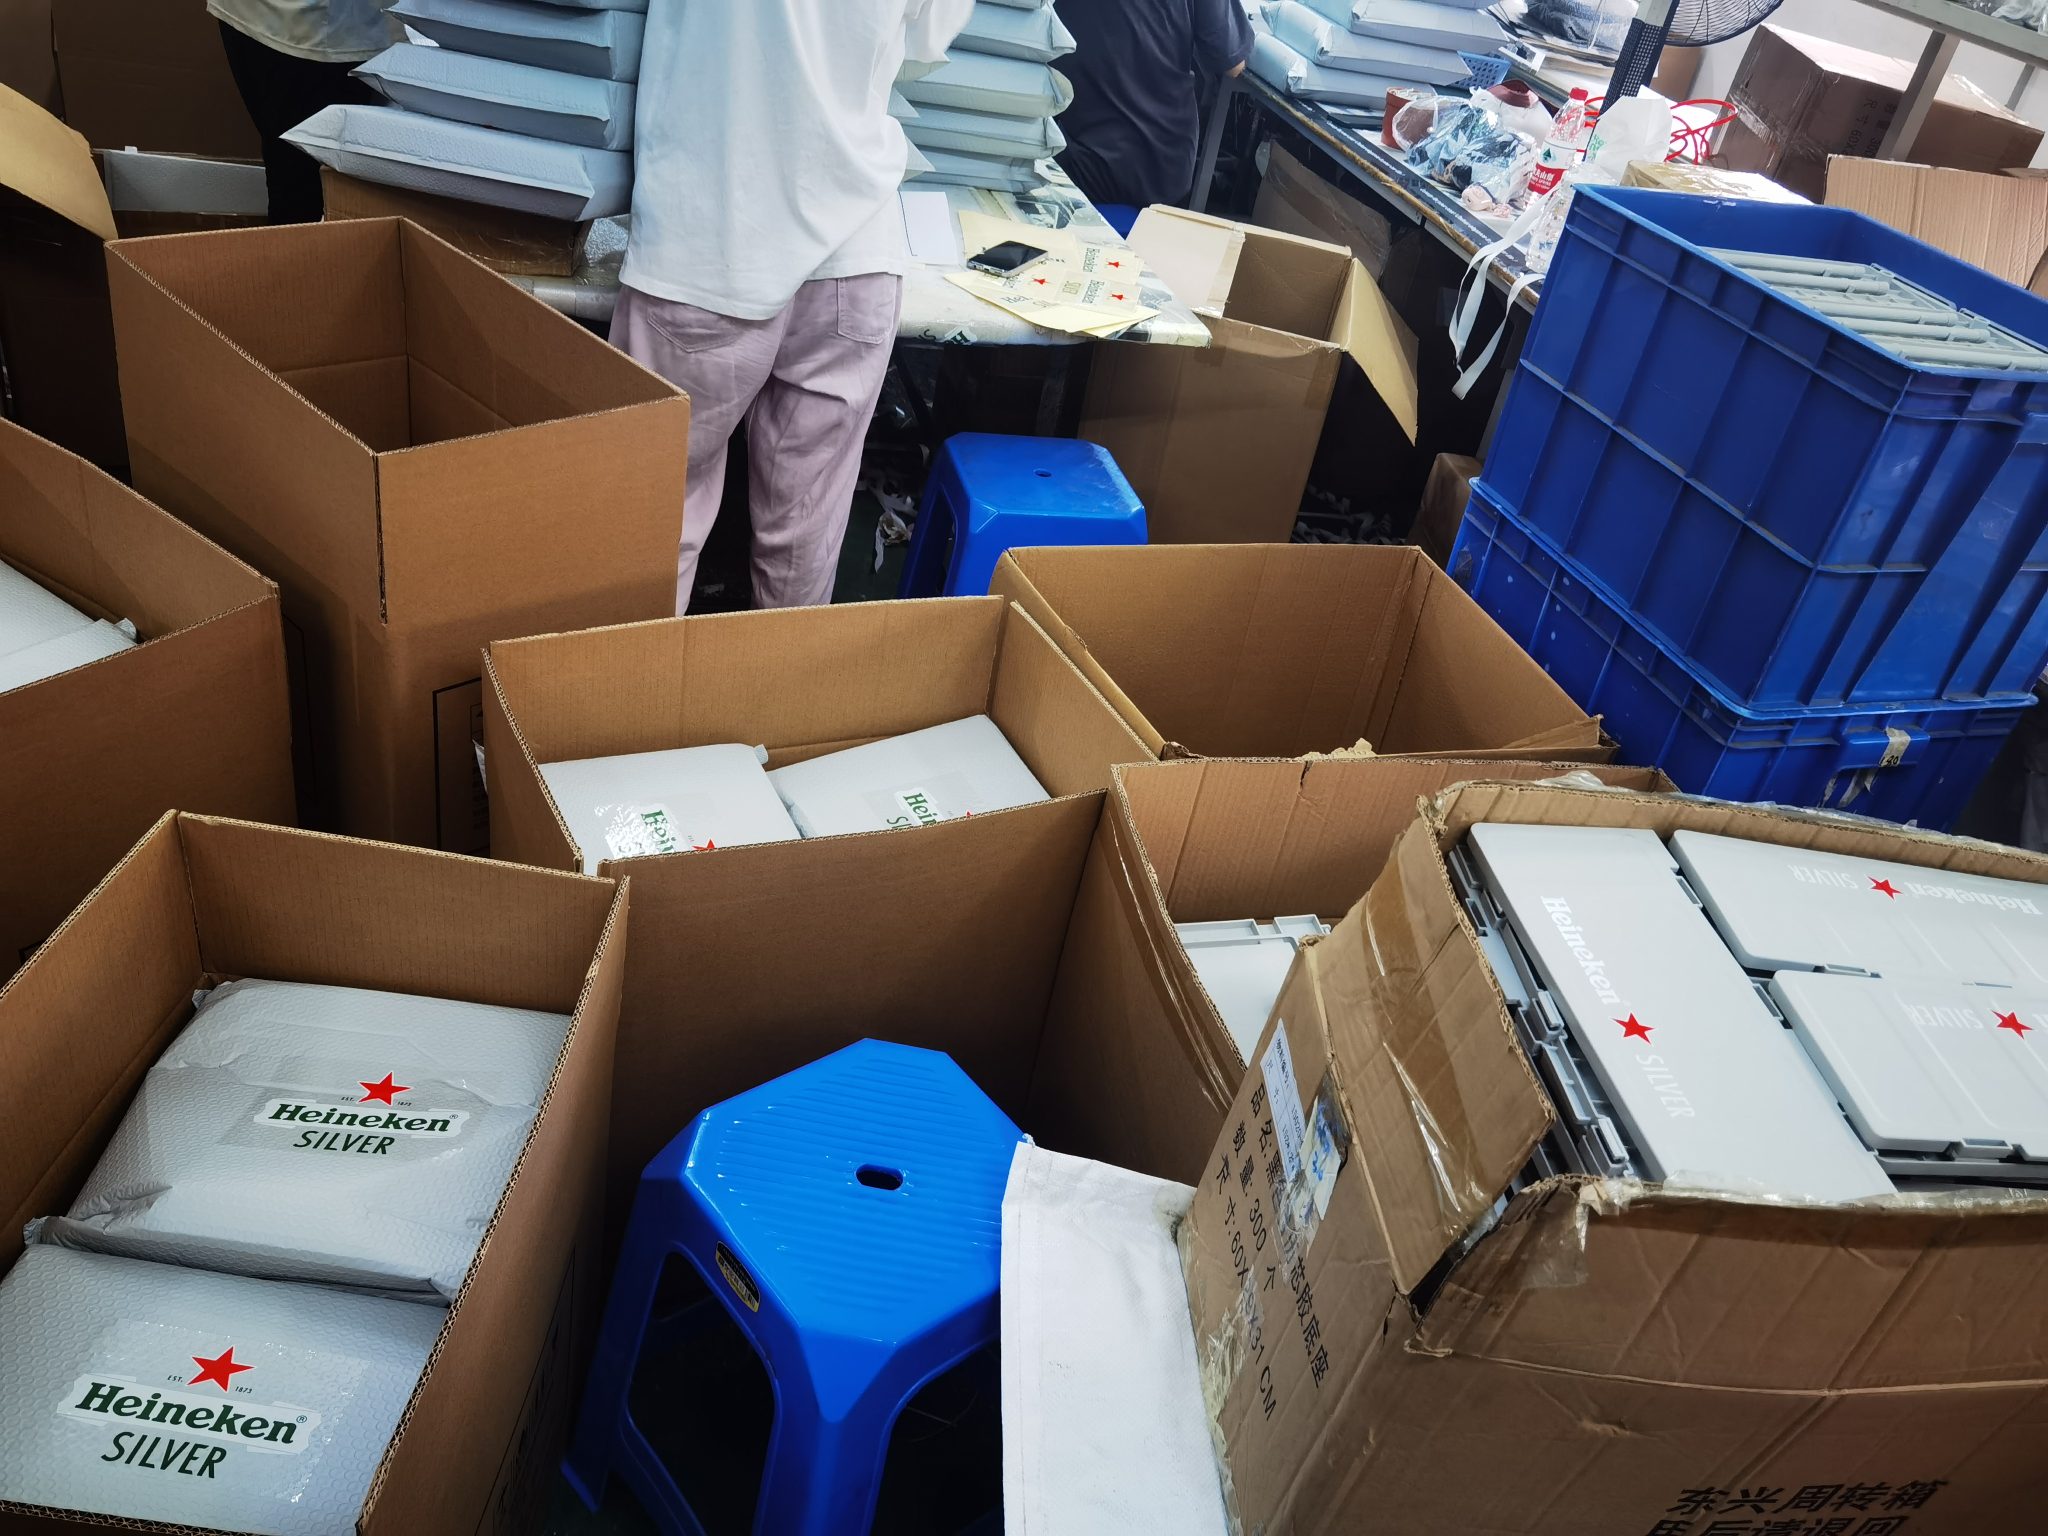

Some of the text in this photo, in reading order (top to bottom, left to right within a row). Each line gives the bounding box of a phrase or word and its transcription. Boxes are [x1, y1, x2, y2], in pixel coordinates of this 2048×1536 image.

[1787, 864, 1859, 890] SILVER
[1540, 895, 1696, 1121] Heineken SILVER
[293, 1130, 395, 1155] SILVER
[167, 1375, 253, 1394] EST. 1873
[101, 1431, 228, 1479] SILVER
[1666, 1479, 1950, 1515] 东兴周转箱
